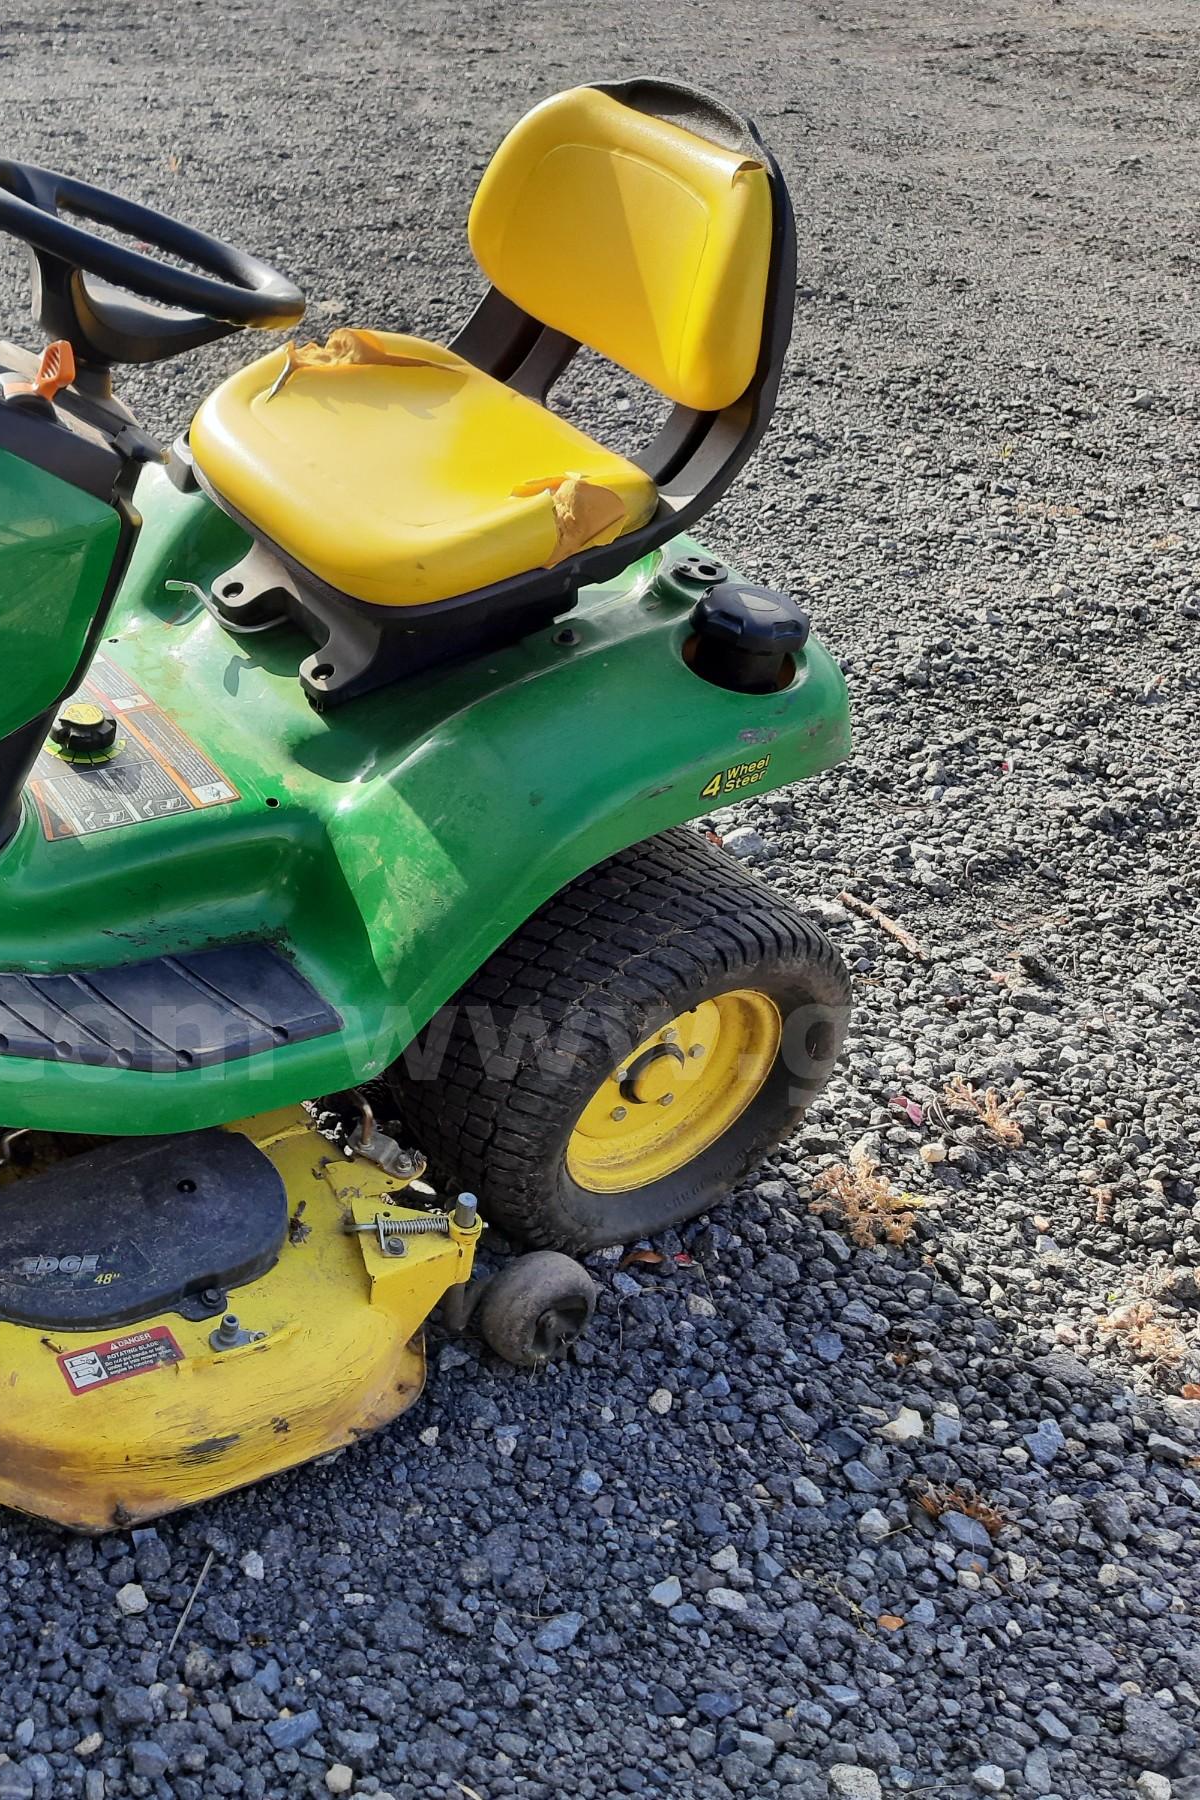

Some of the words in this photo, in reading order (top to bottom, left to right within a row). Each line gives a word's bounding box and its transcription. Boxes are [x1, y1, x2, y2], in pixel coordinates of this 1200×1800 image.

[701, 771, 723, 798] 4
[727, 754, 771, 780] Wheel
[723, 769, 767, 793] Steer
[19, 1254, 99, 1273] EDGE
[118, 1332, 152, 1347] DANGER
